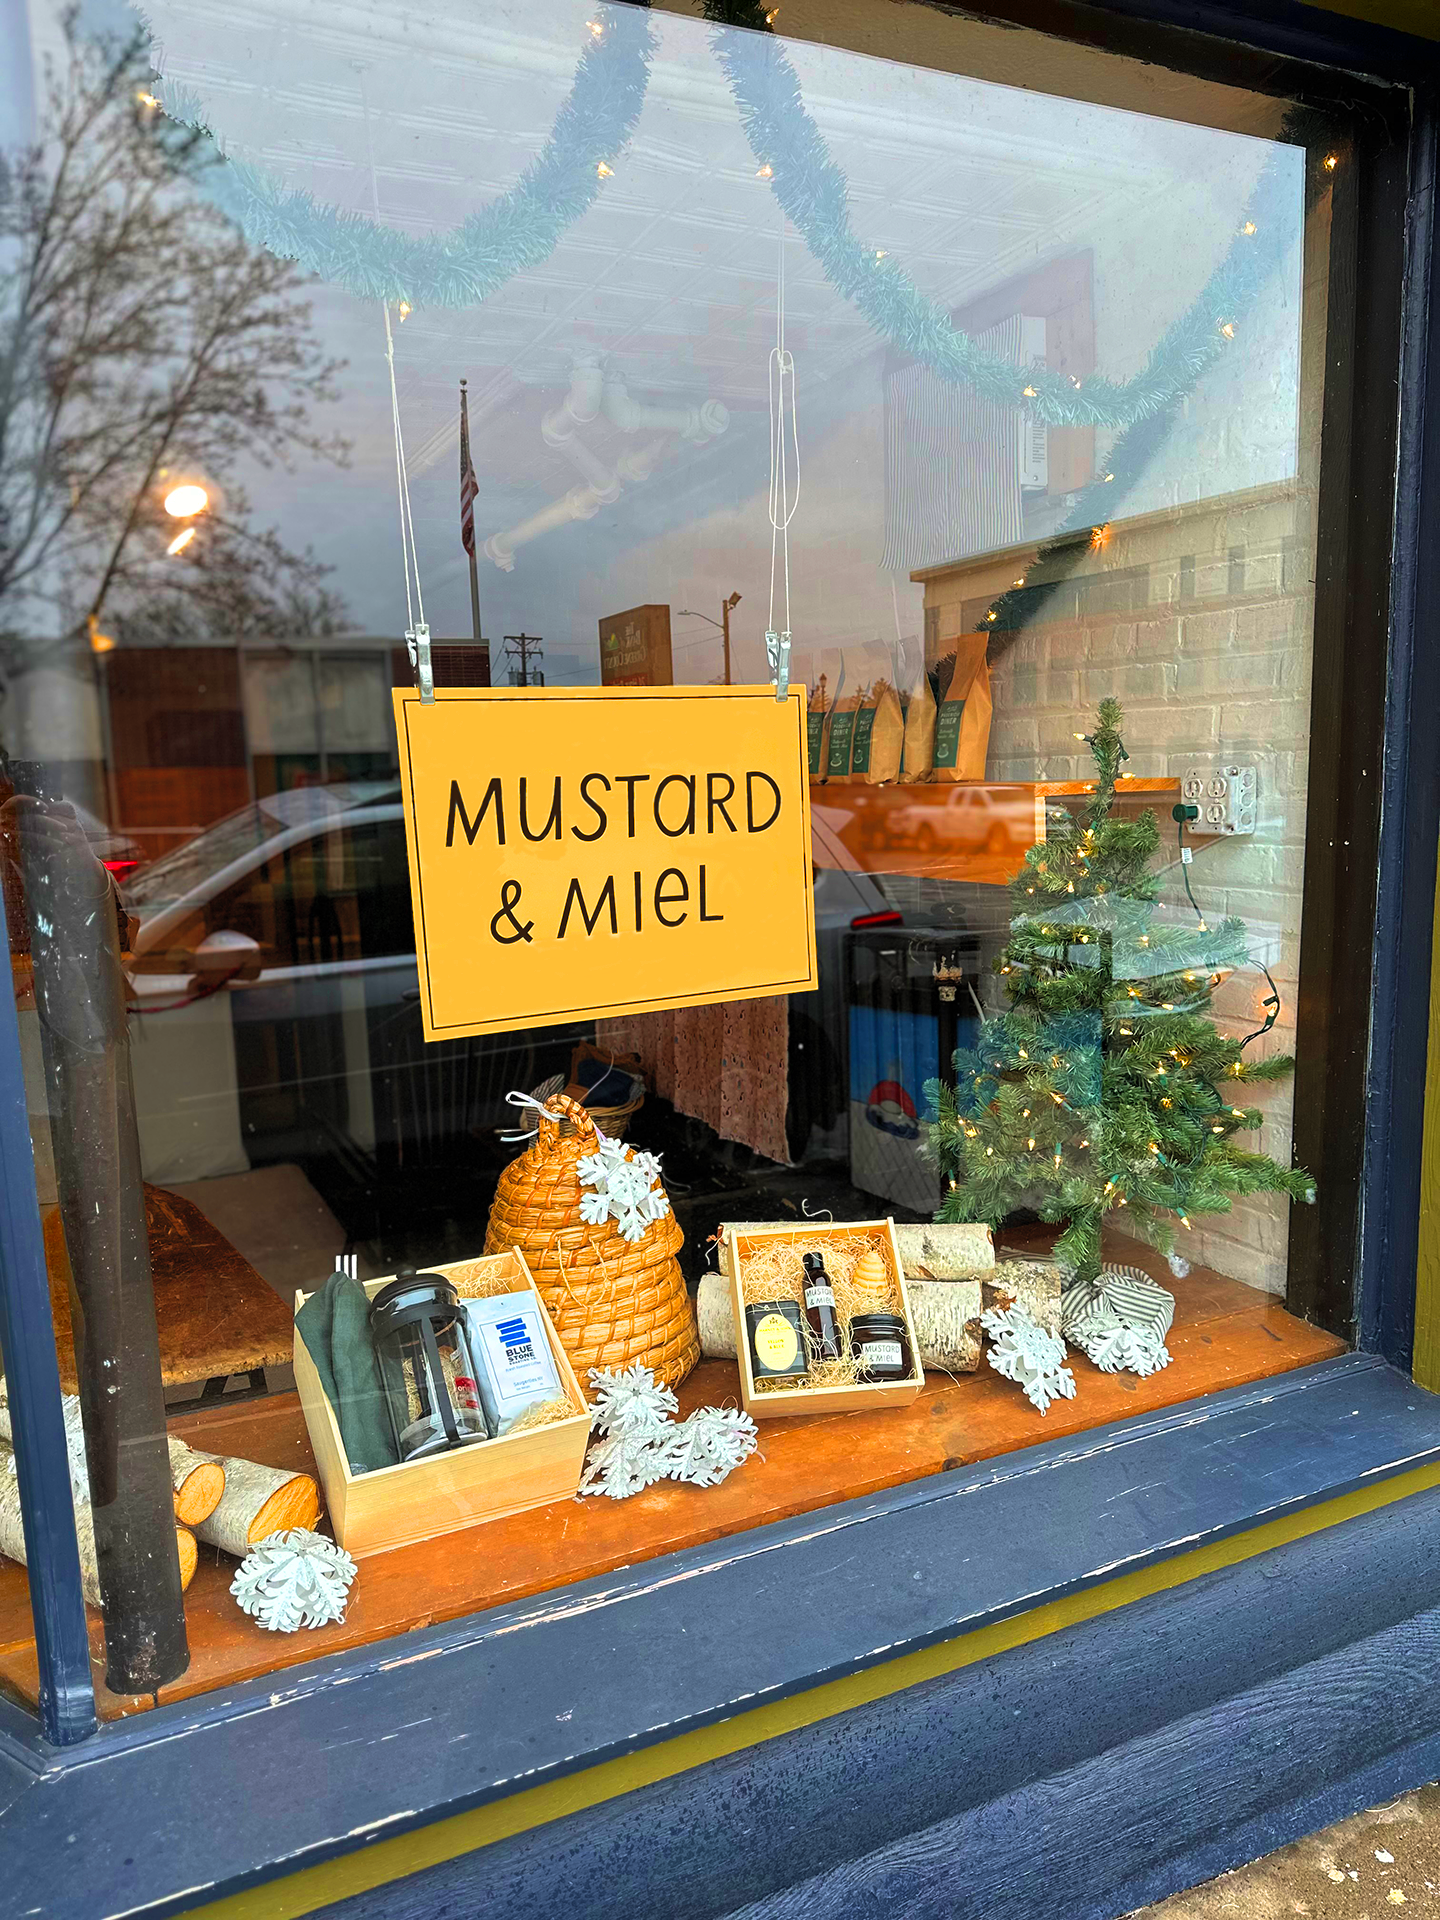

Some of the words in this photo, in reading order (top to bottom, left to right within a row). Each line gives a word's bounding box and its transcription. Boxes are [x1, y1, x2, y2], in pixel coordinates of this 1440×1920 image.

[490, 879, 535, 944] &
[506, 1344, 534, 1357] BLUE
[507, 1352, 536, 1363] STONE
